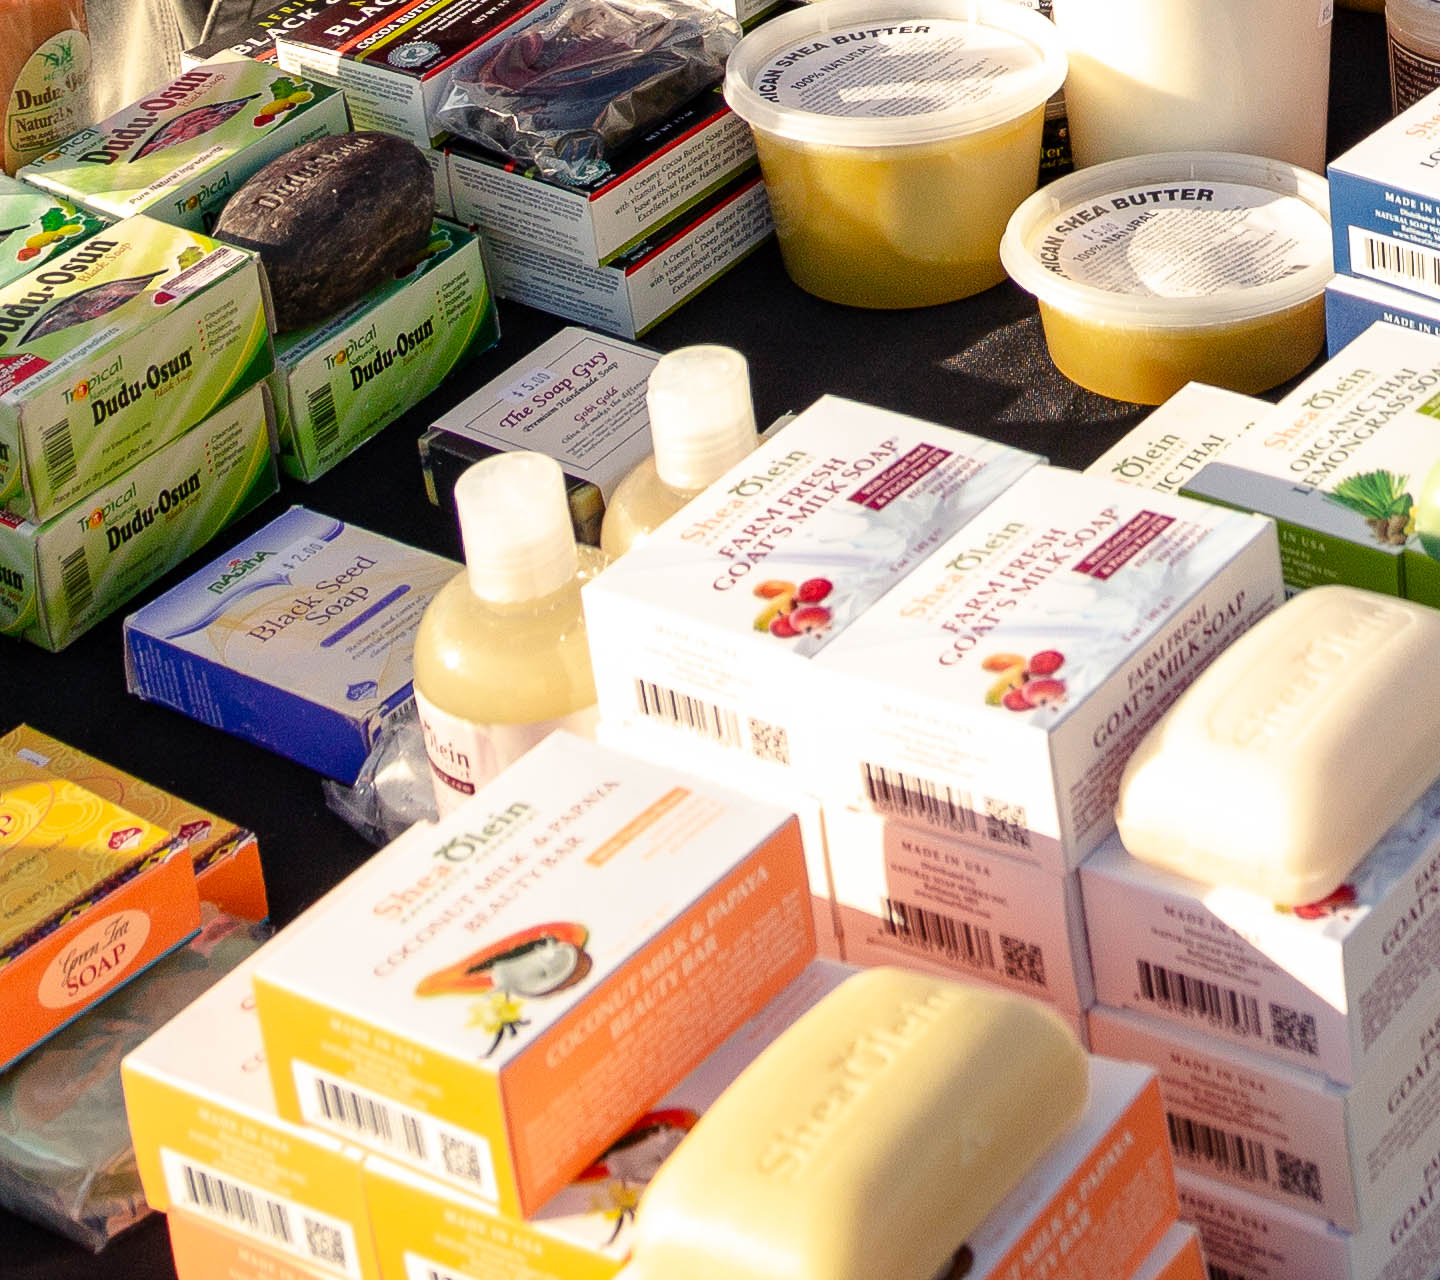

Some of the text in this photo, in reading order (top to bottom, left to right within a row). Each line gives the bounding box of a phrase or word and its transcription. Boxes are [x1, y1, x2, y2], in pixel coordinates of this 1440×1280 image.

[355, 18, 400, 50] COCOA
[774, 26, 931, 69] SHEA BUTTER
[628, 187, 633, 196] A
[634, 172, 660, 191] Creamy
[661, 157, 682, 173] Cocoa
[683, 140, 705, 159] Butter
[1384, 192, 1412, 208] MADE
[1415, 198, 1431, 211] IN
[1056, 188, 1215, 236] SHEA BUTTER
[1072, 208, 1159, 263] 100% NATURAL
[91, 346, 193, 428] Dudu-Osun
[499, 351, 608, 429] The Soap Guy
[523, 362, 619, 433] Premium Handmade Soap
[1289, 365, 1418, 473] ORGANIC THAI
[1290, 392, 1411, 497] LEMONGRASS
[712, 436, 901, 593] GOAT'S MILK SOAP
[715, 457, 848, 562] FARM FRESH
[248, 593, 322, 643] Black
[316, 556, 378, 594] Seed
[304, 586, 370, 626] Soap
